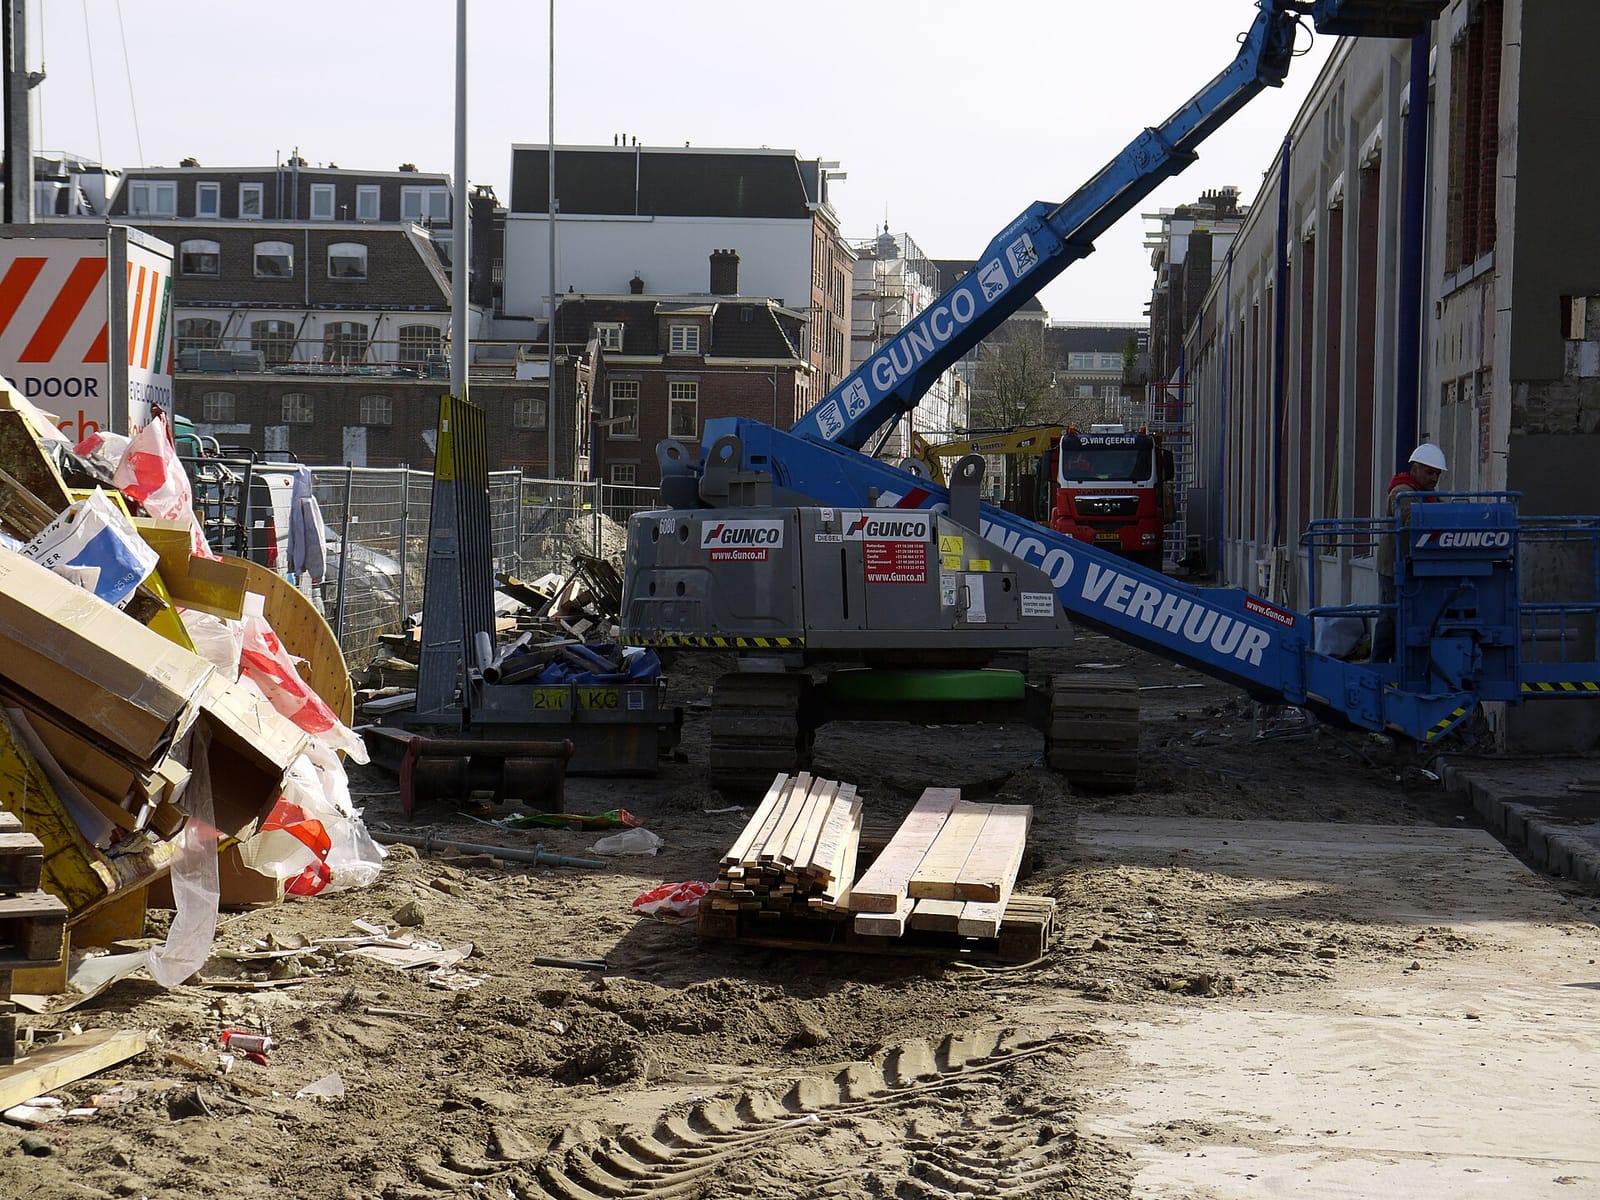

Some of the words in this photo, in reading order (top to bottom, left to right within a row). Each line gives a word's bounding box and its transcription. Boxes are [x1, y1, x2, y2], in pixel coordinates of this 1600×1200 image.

[871, 288, 975, 391] GUNCO
[25, 377, 98, 397] DOOR
[721, 528, 779, 544] GUNCO
[866, 521, 926, 538] GUNCO
[1438, 532, 1510, 547] GUNCO
[711, 549, 766, 561] www.Gunco.nl
[123, 572, 135, 583] kg
[867, 572, 925, 582] www.Gunco.nl
[980, 518, 1075, 588] NCO
[1080, 562, 1271, 667] VERHUUR
[1245, 600, 1294, 626] www.Gunco.nl
[589, 690, 618, 709] KG
